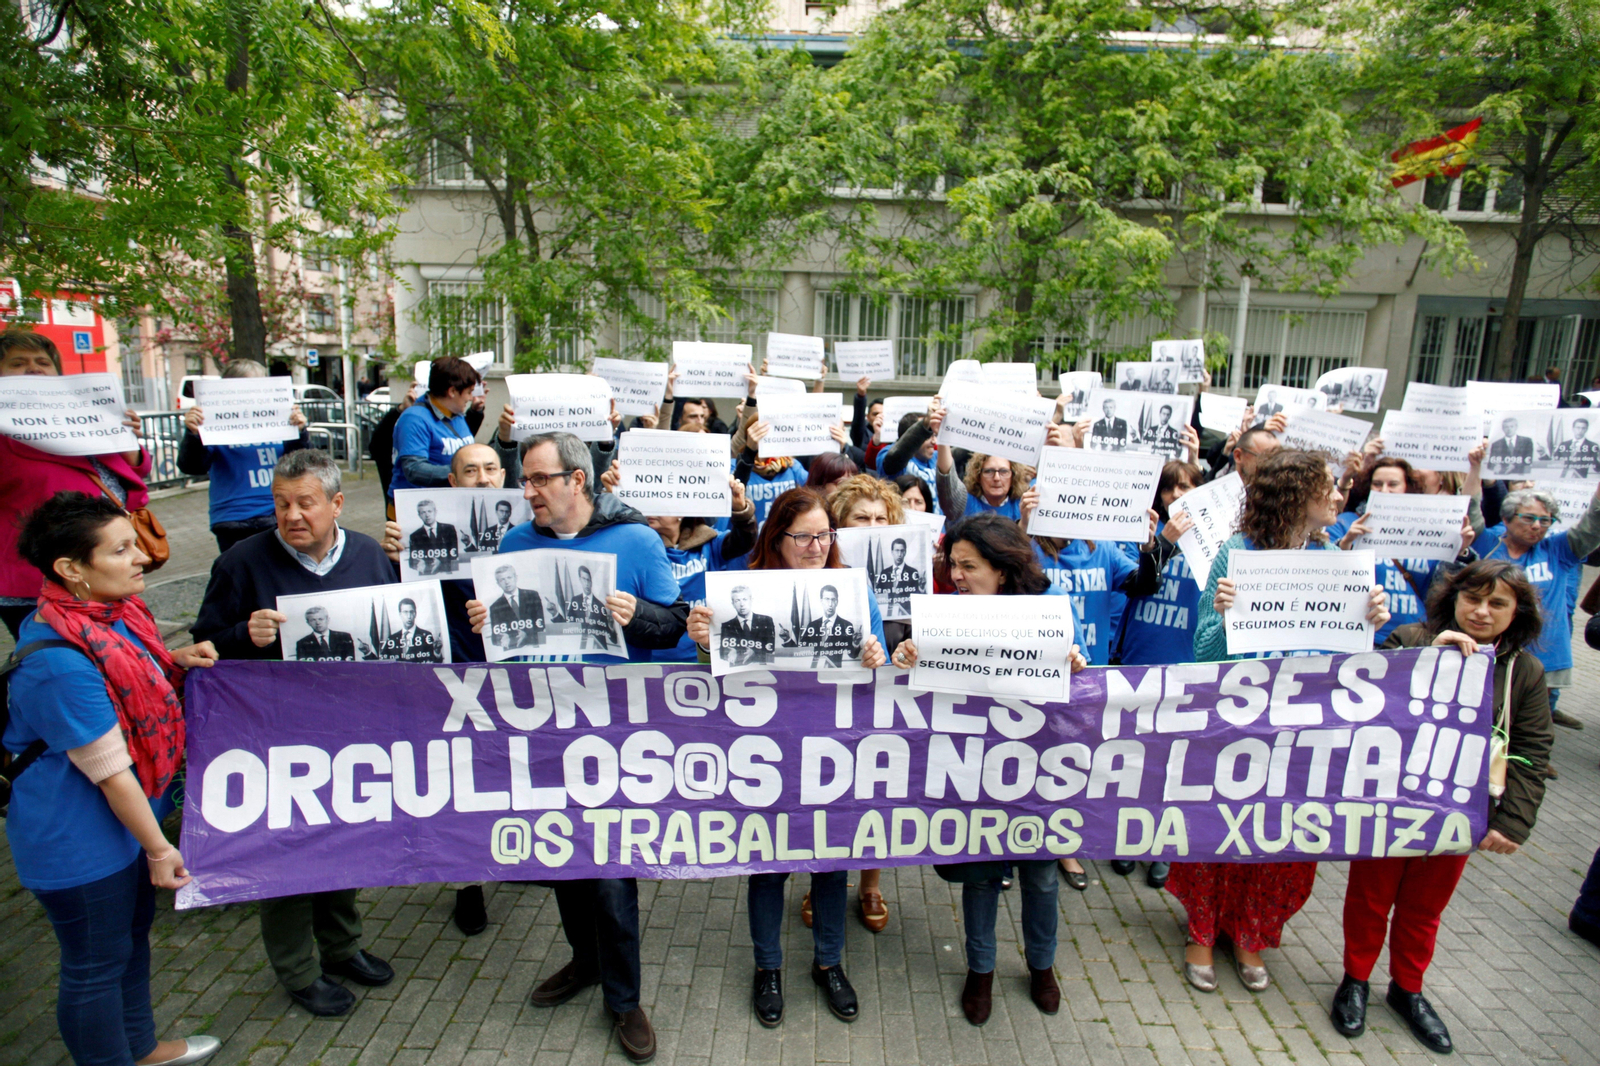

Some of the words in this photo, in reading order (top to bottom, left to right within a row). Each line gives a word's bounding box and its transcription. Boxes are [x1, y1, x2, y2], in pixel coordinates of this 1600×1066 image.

[20, 402, 65, 410] DECIMOS
[68, 400, 89, 409] QUE
[92, 397, 115, 406] NON
[215, 412, 239, 420] NON
[243, 409, 249, 418] É
[252, 409, 279, 418] NON!
[559, 406, 564, 415] É
[974, 406, 1007, 419] DECIMOS
[1008, 414, 1026, 423] QUE
[1026, 418, 1043, 427] NON
[12, 417, 47, 426] NON
[52, 414, 62, 425] É
[65, 414, 104, 425] NON!
[517, 422, 563, 430] SEGUIMOS
[89, 427, 128, 437] FOLGA
[204, 424, 249, 432] SEGUIMOS
[961, 417, 986, 429] NON
[989, 422, 995, 432] É
[998, 426, 1027, 439] NON!
[944, 425, 991, 442] SEGUIMOS
[993, 438, 1005, 446] EN
[1007, 442, 1035, 453] FOLGA
[645, 459, 684, 467] DECIMOS
[686, 460, 703, 468] QUE
[1525, 456, 1531, 464] €
[1058, 463, 1092, 472] VOTACIÓN
[1094, 466, 1123, 474] DIXEMOS
[635, 474, 662, 484] NON
[668, 472, 674, 484] É
[679, 476, 710, 484] NON!
[1044, 475, 1068, 485] HOXE
[1071, 478, 1110, 488] DECIMOS
[1113, 481, 1129, 490] QUE
[619, 490, 673, 498] SEGUIMOS
[1058, 494, 1086, 505] NON
[1090, 494, 1098, 506] É
[1102, 498, 1133, 508] NON!
[1038, 509, 1093, 521] SEGUIMOS
[1096, 514, 1110, 522] EN
[1113, 515, 1142, 523] FOLGA
[1392, 515, 1427, 524] DECIMOS
[1429, 517, 1443, 525] QUE
[1380, 527, 1404, 535] NON
[1407, 527, 1415, 536] É
[1362, 538, 1408, 546] SEGUIMOS
[1424, 541, 1454, 549] FOLGA
[411, 548, 447, 559] 68.098
[450, 548, 457, 556] €
[1249, 566, 1289, 575] VOTACIÓN
[875, 572, 910, 582] 79.518
[912, 572, 919, 580] €
[1235, 583, 1262, 591] HOXE
[1265, 583, 1313, 591] DECIMOS
[1317, 584, 1340, 593] QUE
[1343, 584, 1370, 592] NON
[565, 601, 599, 613] 79.518
[1250, 601, 1285, 612] NON
[1290, 598, 1299, 611] É
[1304, 602, 1346, 612] NON!
[1134, 600, 1189, 630] LOITA
[493, 620, 533, 634] 68.098
[535, 619, 543, 628] €
[800, 626, 842, 637] 79.518
[845, 626, 853, 636] €
[1232, 620, 1295, 630] SEGUIMOS
[1299, 620, 1316, 628] EN
[1320, 621, 1364, 631] FOLGA
[922, 628, 952, 637] HOXE
[956, 628, 1007, 638] DECIMOS
[1011, 629, 1034, 639] QUE
[1038, 630, 1064, 638] NON
[380, 636, 422, 650] 79.518
[426, 634, 434, 644] €
[722, 638, 762, 649] 68.098
[765, 642, 773, 651] €
[941, 648, 979, 656] NON
[985, 645, 995, 657] É
[1000, 649, 1043, 660] NON!
[919, 660, 990, 675] SEGUIMOS
[995, 668, 1012, 676] EN
[1017, 668, 1060, 678] FOLGA
[432, 665, 778, 731] XUNT@S
[817, 667, 1046, 739] TRES
[1102, 652, 1388, 740] MESES
[201, 730, 782, 833] ORGULLOS@S
[800, 734, 910, 805] DA
[925, 734, 1145, 803] NOSA
[491, 810, 573, 867] @S
[583, 807, 1084, 866] TRABALLADOR@S
[1115, 806, 1189, 856] DA
